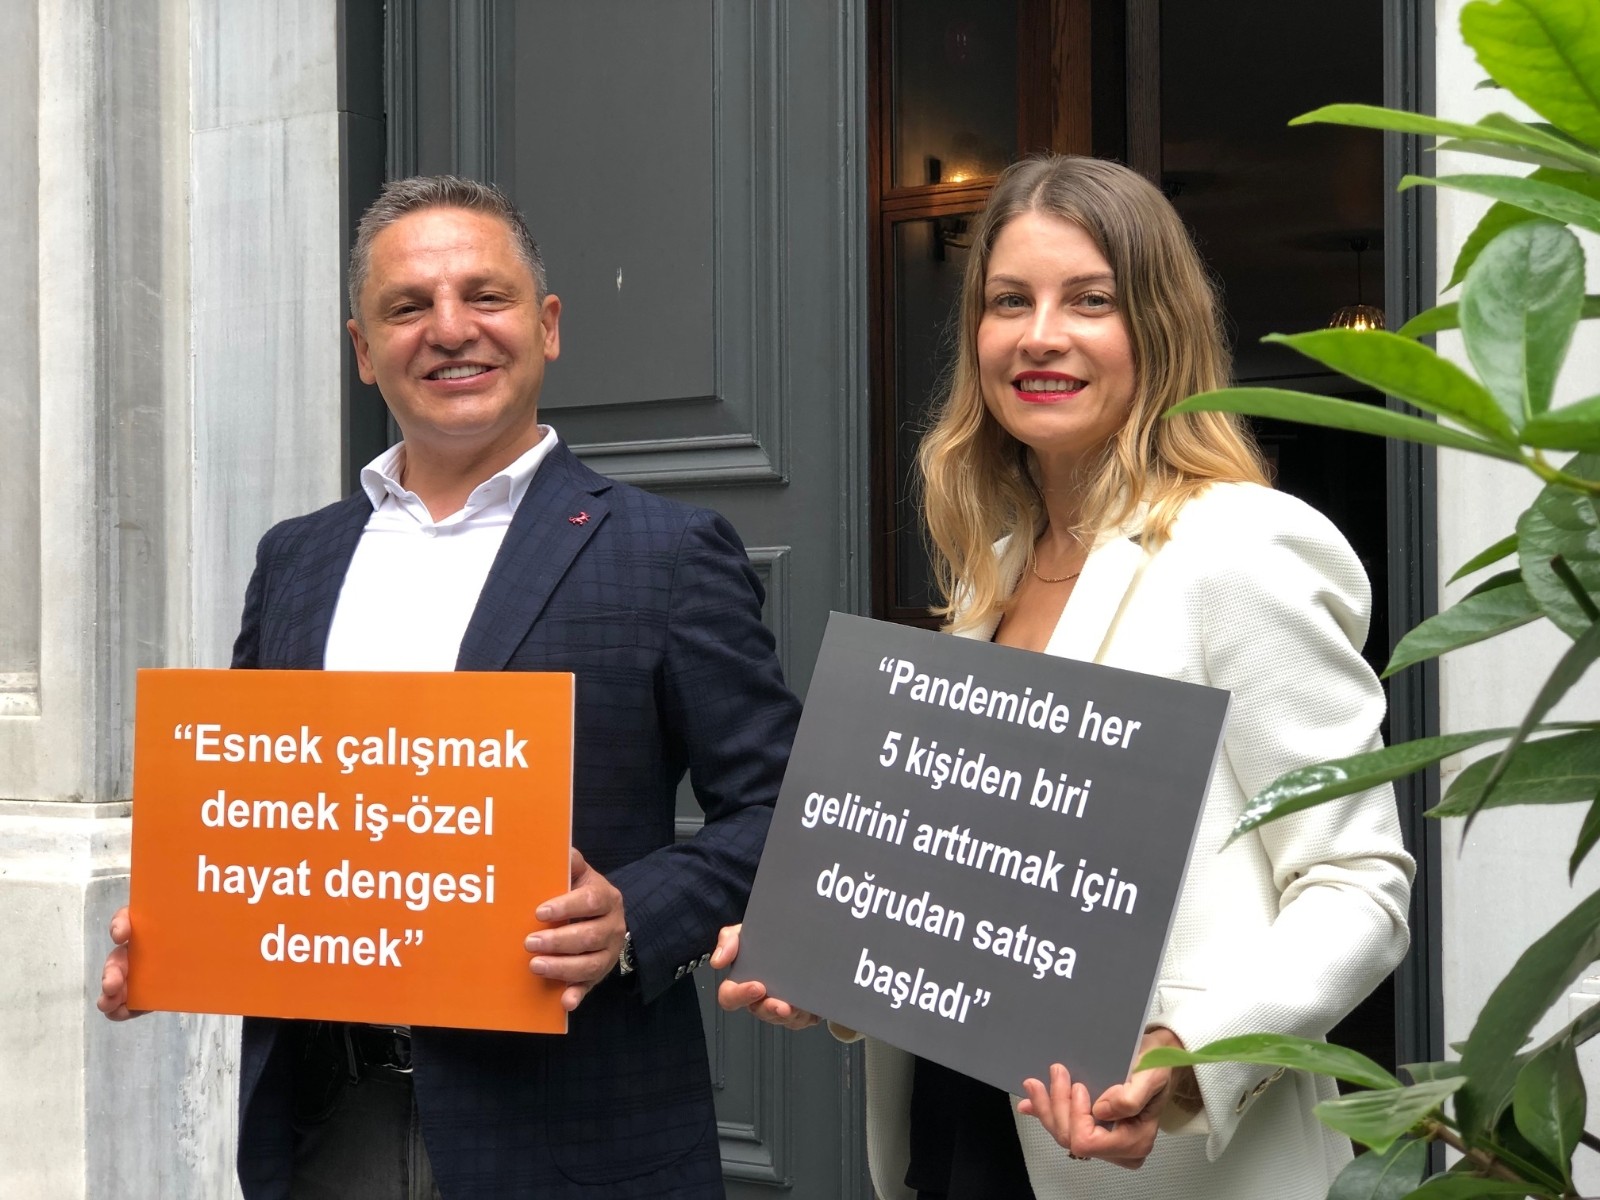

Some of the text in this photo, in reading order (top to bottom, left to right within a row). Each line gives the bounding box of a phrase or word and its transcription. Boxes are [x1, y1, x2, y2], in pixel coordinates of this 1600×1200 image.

[878, 656, 1142, 749] “Pandemide her
[174, 723, 529, 776] “Esnek çalışmak
[879, 730, 1093, 819] 5 kişiden biri
[201, 789, 493, 842] demek iş-özel
[801, 791, 1138, 915] gelirini arttırmak için
[197, 854, 495, 912] hayat dengesi
[816, 862, 1077, 980] doğrudan satışa
[260, 923, 424, 967] demek”
[853, 947, 992, 1024] başladı”
